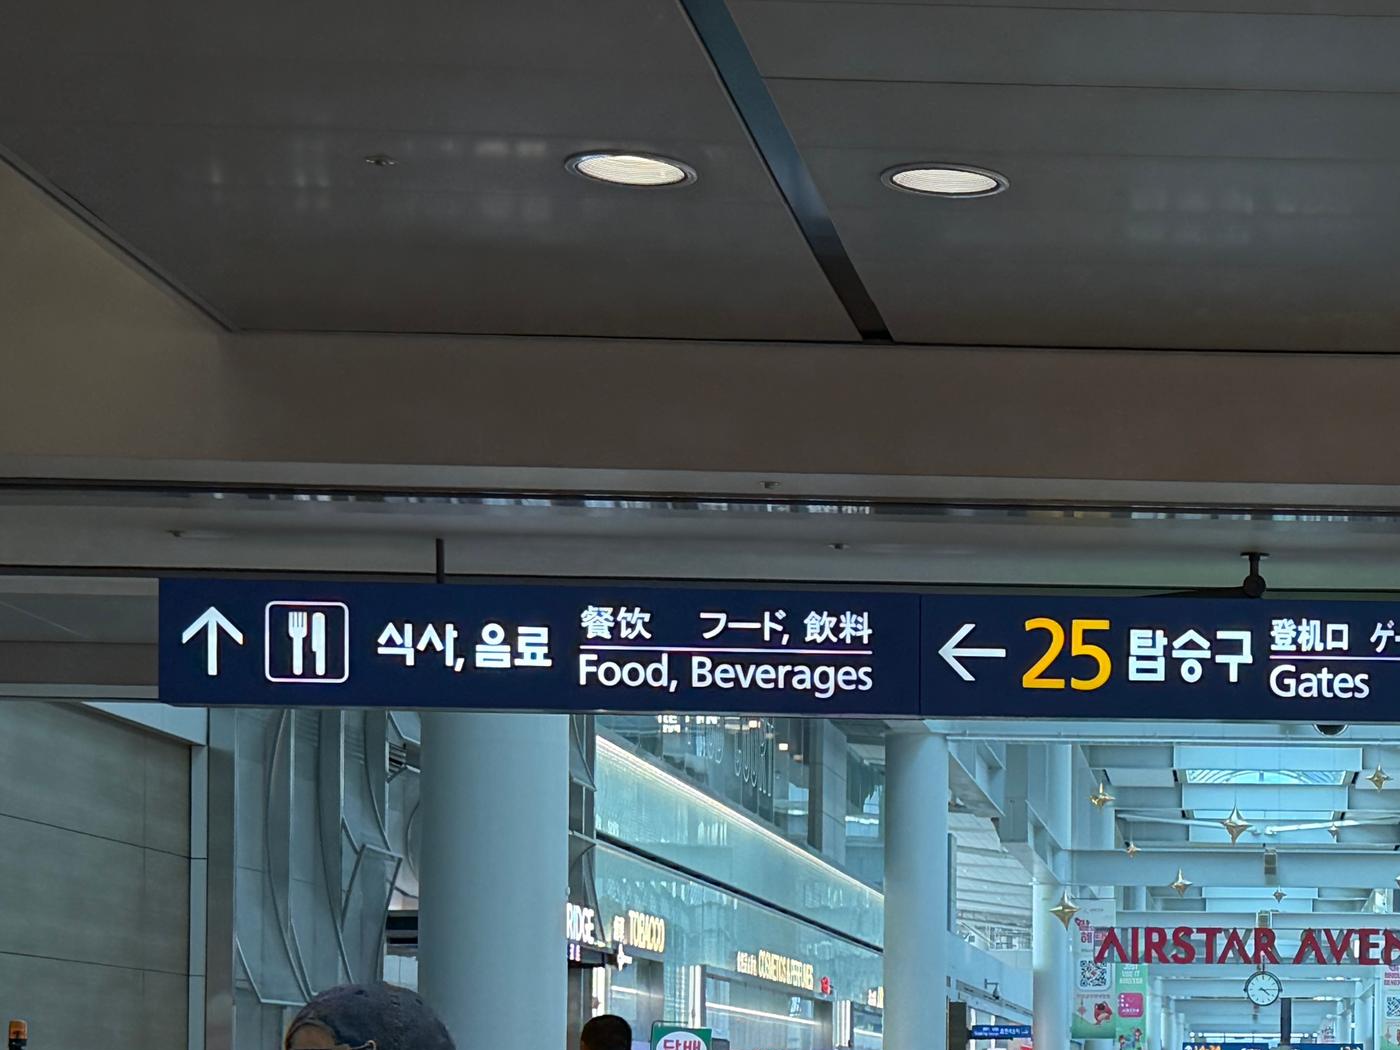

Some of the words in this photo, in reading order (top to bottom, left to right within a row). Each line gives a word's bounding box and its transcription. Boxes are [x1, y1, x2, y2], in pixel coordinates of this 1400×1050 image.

[580, 605, 652, 640] 餐饮
[1270, 618, 1349, 652] 登机口
[1022, 617, 1112, 691] 25
[1128, 629, 1253, 683] 탑승구
[579, 653, 678, 693] Food,
[691, 655, 873, 699] Beverages
[1269, 664, 1370, 699] Gates
[566, 902, 594, 945] RIDGE
[628, 909, 665, 953] TOBACCO
[1094, 926, 1279, 964] AIRSTAR
